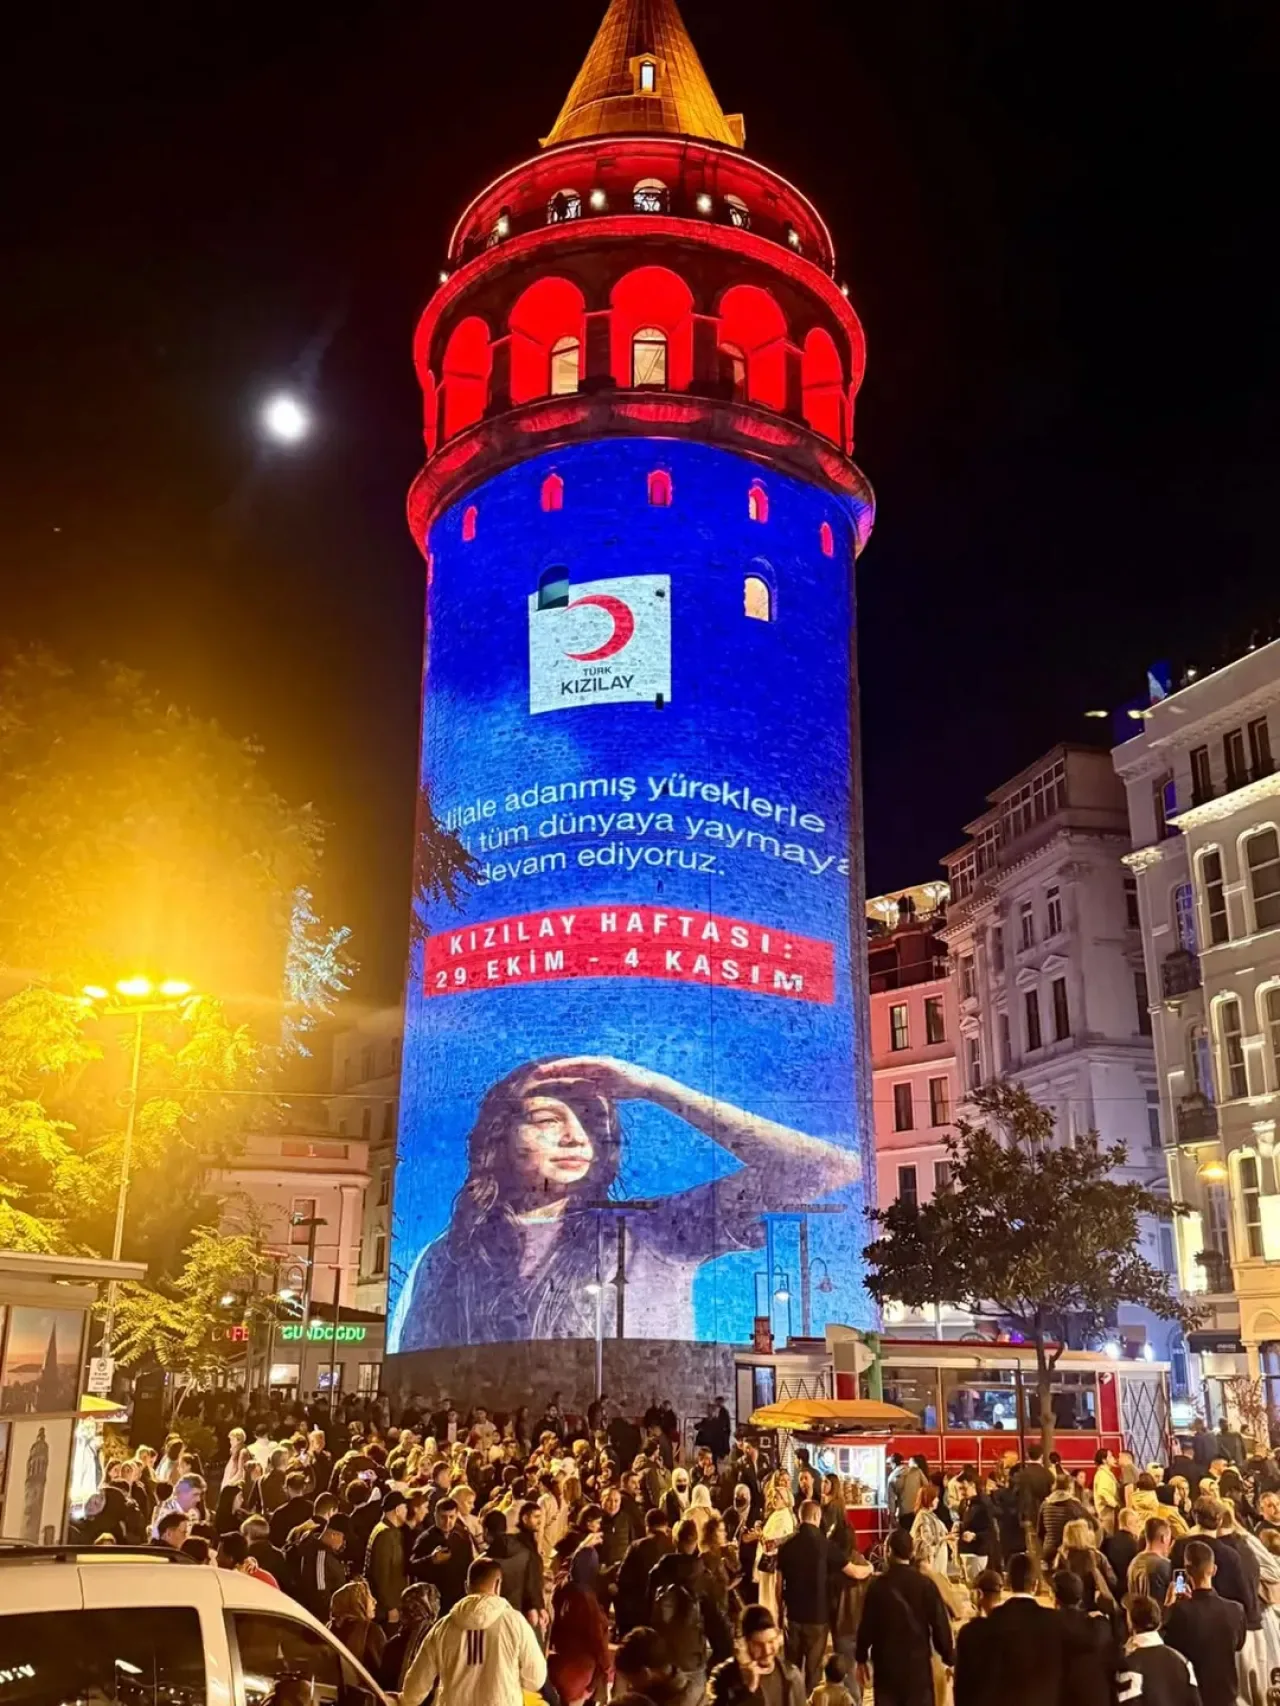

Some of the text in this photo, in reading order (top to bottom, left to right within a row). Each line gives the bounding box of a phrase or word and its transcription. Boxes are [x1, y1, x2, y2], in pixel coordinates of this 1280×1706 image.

[561, 675, 634, 695] KIZILAY
[582, 666, 612, 676] TÜRK
[504, 776, 637, 802] adanmış
[648, 772, 826, 833] yüreklerle
[479, 825, 529, 852] tüm
[538, 811, 674, 837] dünyaya
[476, 841, 725, 886] devam ediyoruz.
[451, 914, 575, 956] KIZILAY
[436, 967, 467, 988] 29
[487, 950, 564, 980] EKİM
[625, 948, 639, 968] 4
[665, 949, 804, 992] KASIM
